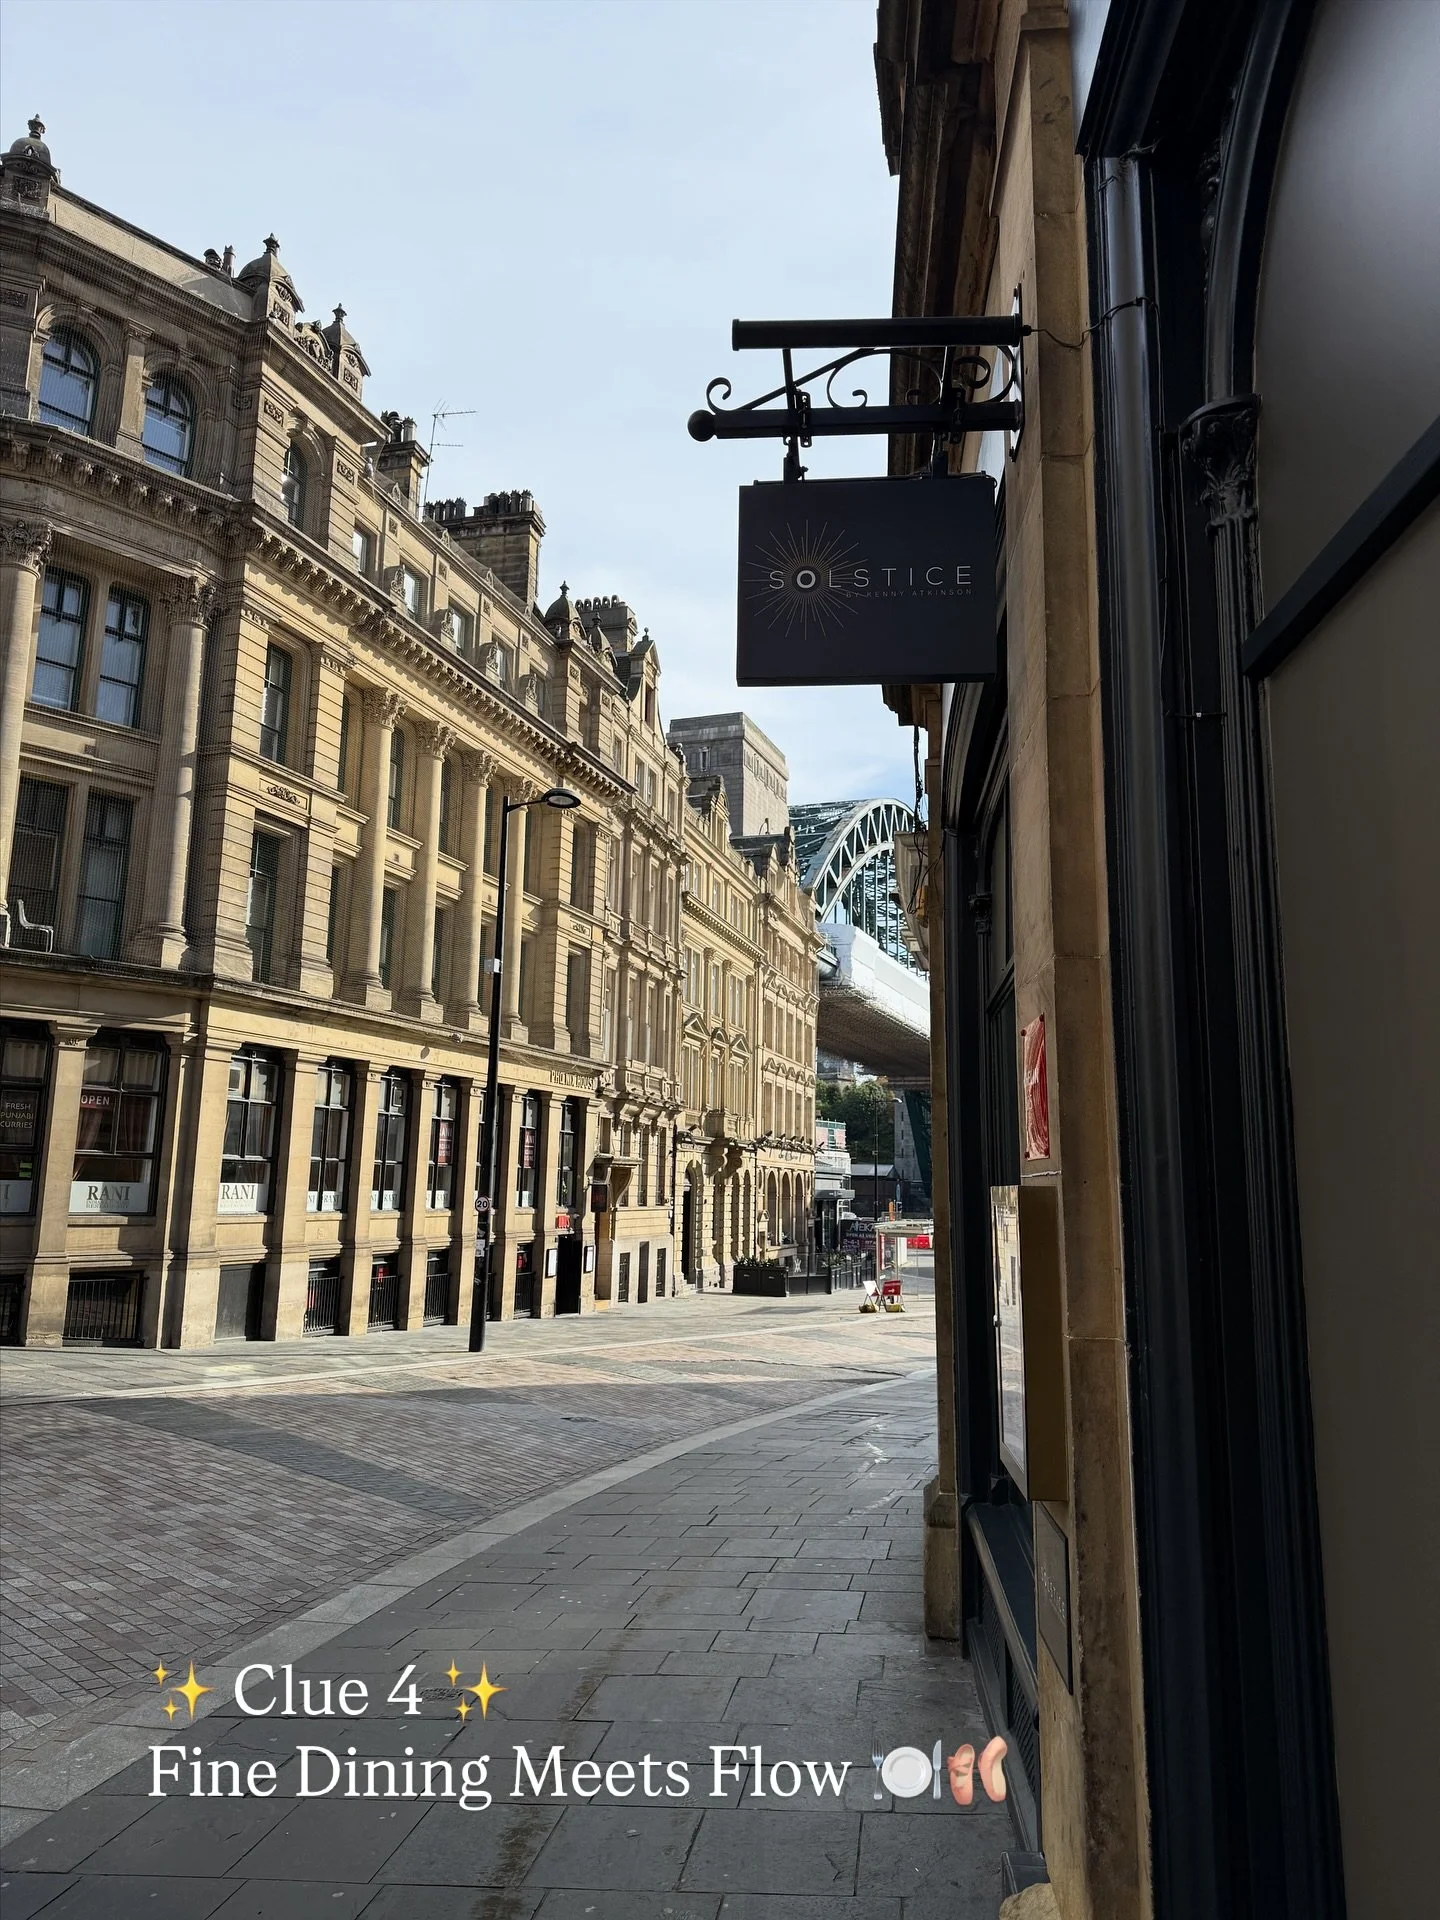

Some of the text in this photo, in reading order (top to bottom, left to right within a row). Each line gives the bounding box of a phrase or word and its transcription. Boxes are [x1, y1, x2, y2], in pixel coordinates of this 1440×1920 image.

[768, 564, 973, 590] SOLSTICE
[866, 590, 905, 598] KENNY
[912, 588, 973, 597] ATKINSON
[80, 1094, 110, 1106] OPEN
[6, 1102, 31, 1110] FRESH
[0, 1111, 34, 1119] PUNJABI
[0, 1120, 33, 1128] CURRIES
[86, 1185, 130, 1200] RANI
[221, 1184, 255, 1200] RANI
[477, 1200, 488, 1208] 20
